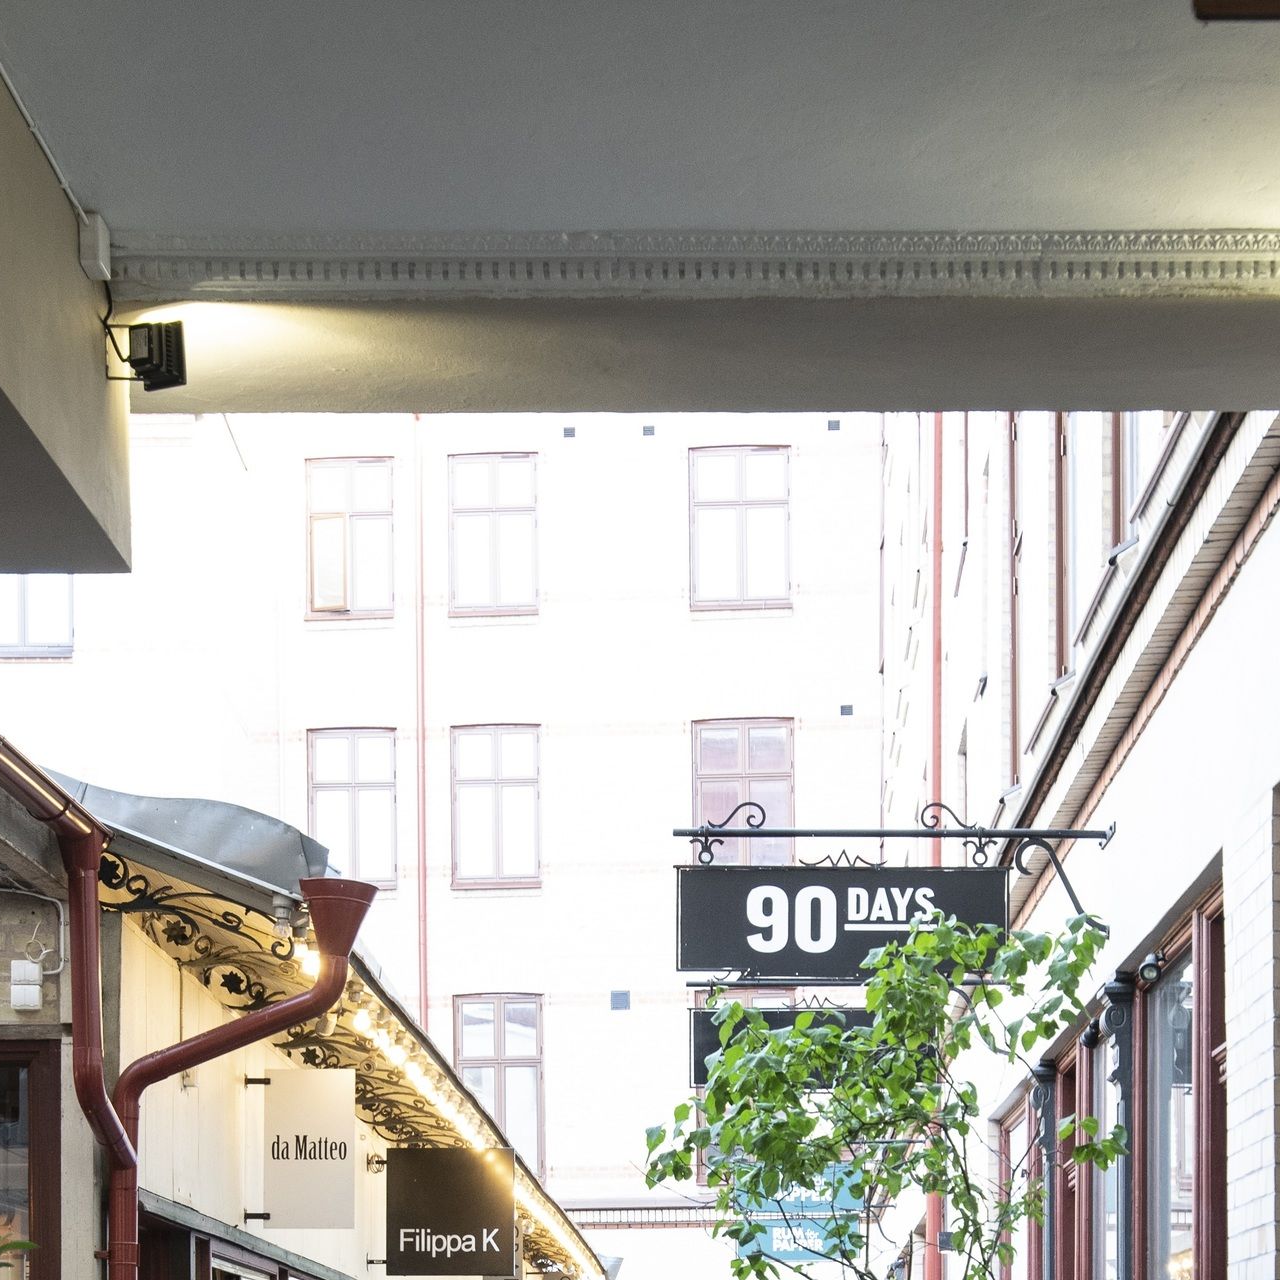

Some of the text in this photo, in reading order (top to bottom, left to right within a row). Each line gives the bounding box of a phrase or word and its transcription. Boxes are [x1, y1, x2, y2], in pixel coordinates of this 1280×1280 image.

[746, 885, 937, 954] 90 DAYS
[271, 1134, 347, 1161] da Matteo
[399, 1228, 500, 1258] Filippa K
